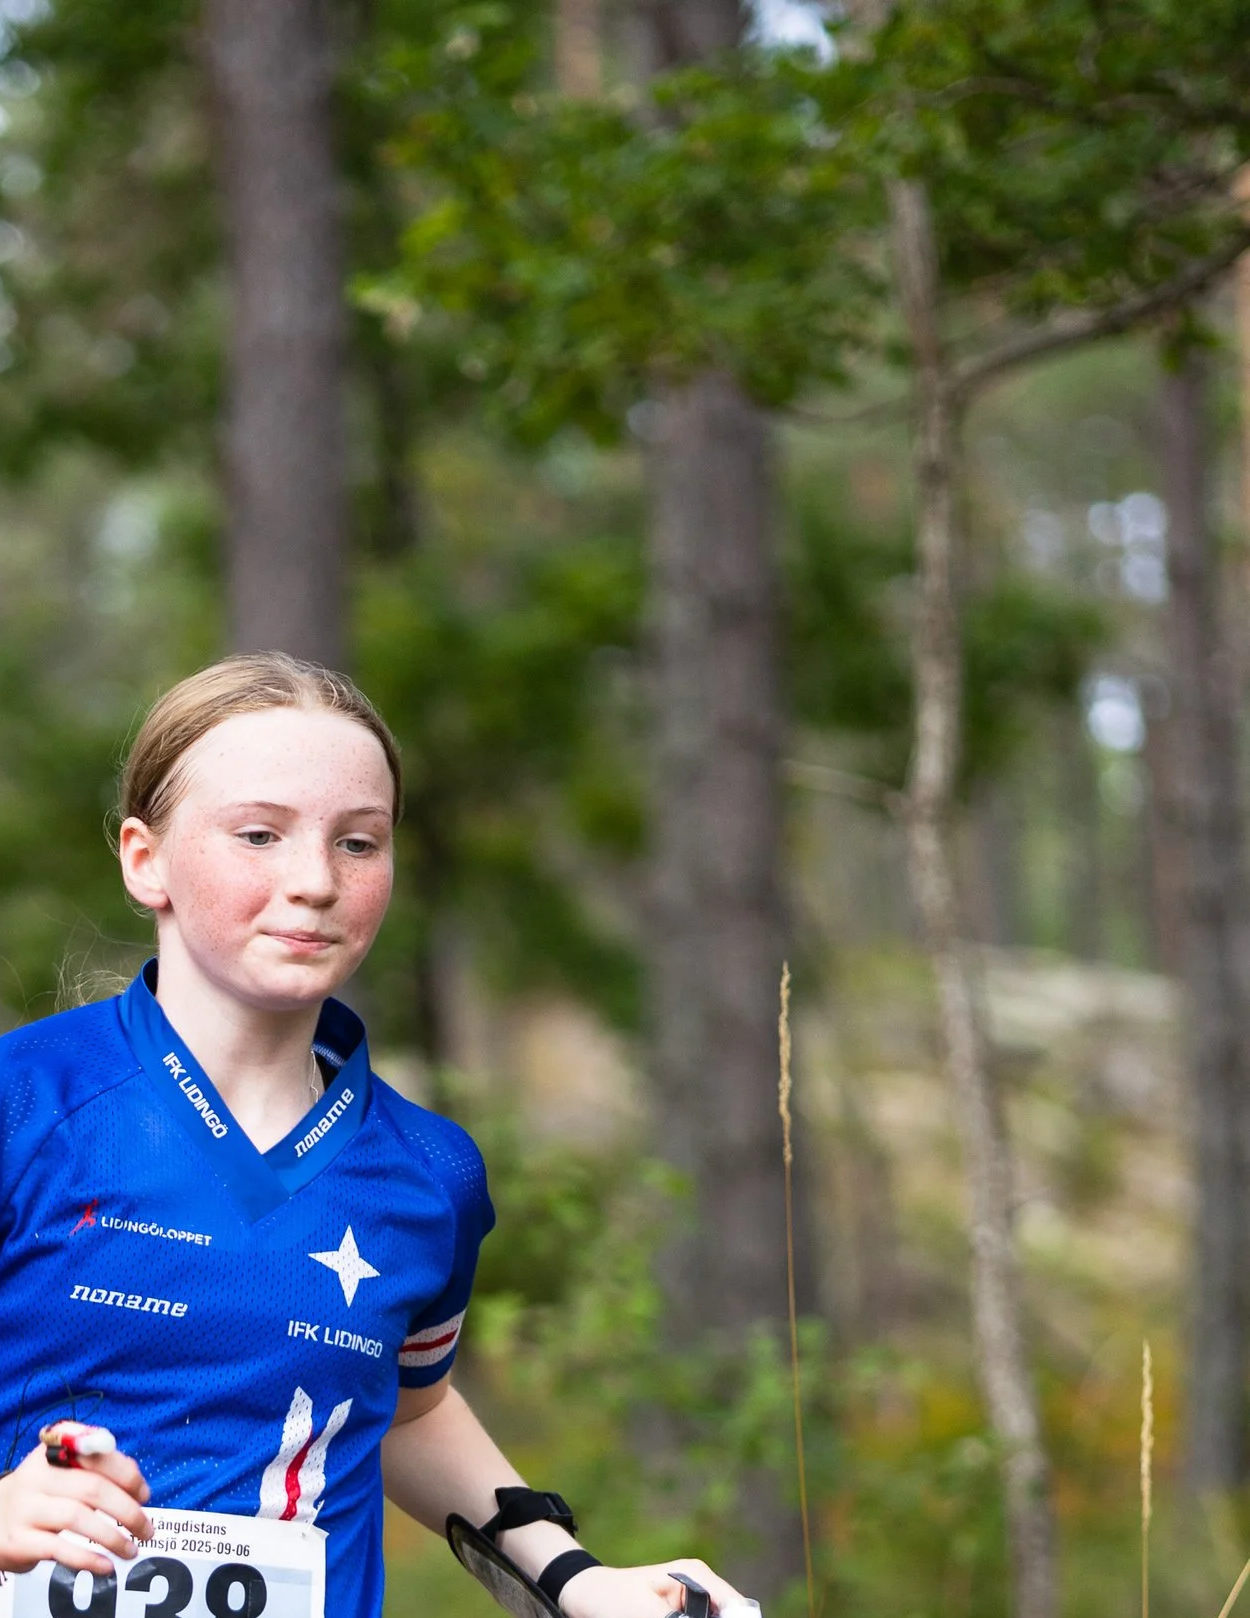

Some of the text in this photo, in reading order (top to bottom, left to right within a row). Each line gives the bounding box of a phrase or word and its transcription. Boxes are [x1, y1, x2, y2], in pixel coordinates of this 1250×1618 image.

[162, 1051, 228, 1139] IFK LIDINGÖ
[293, 1087, 355, 1158] noname
[100, 1215, 213, 1247] LIDINGÖLOPPET
[69, 1284, 189, 1318] noname
[287, 1319, 384, 1359] IFK LIDINGÖ
[181, 1538, 251, 1558] 2025-09-06
